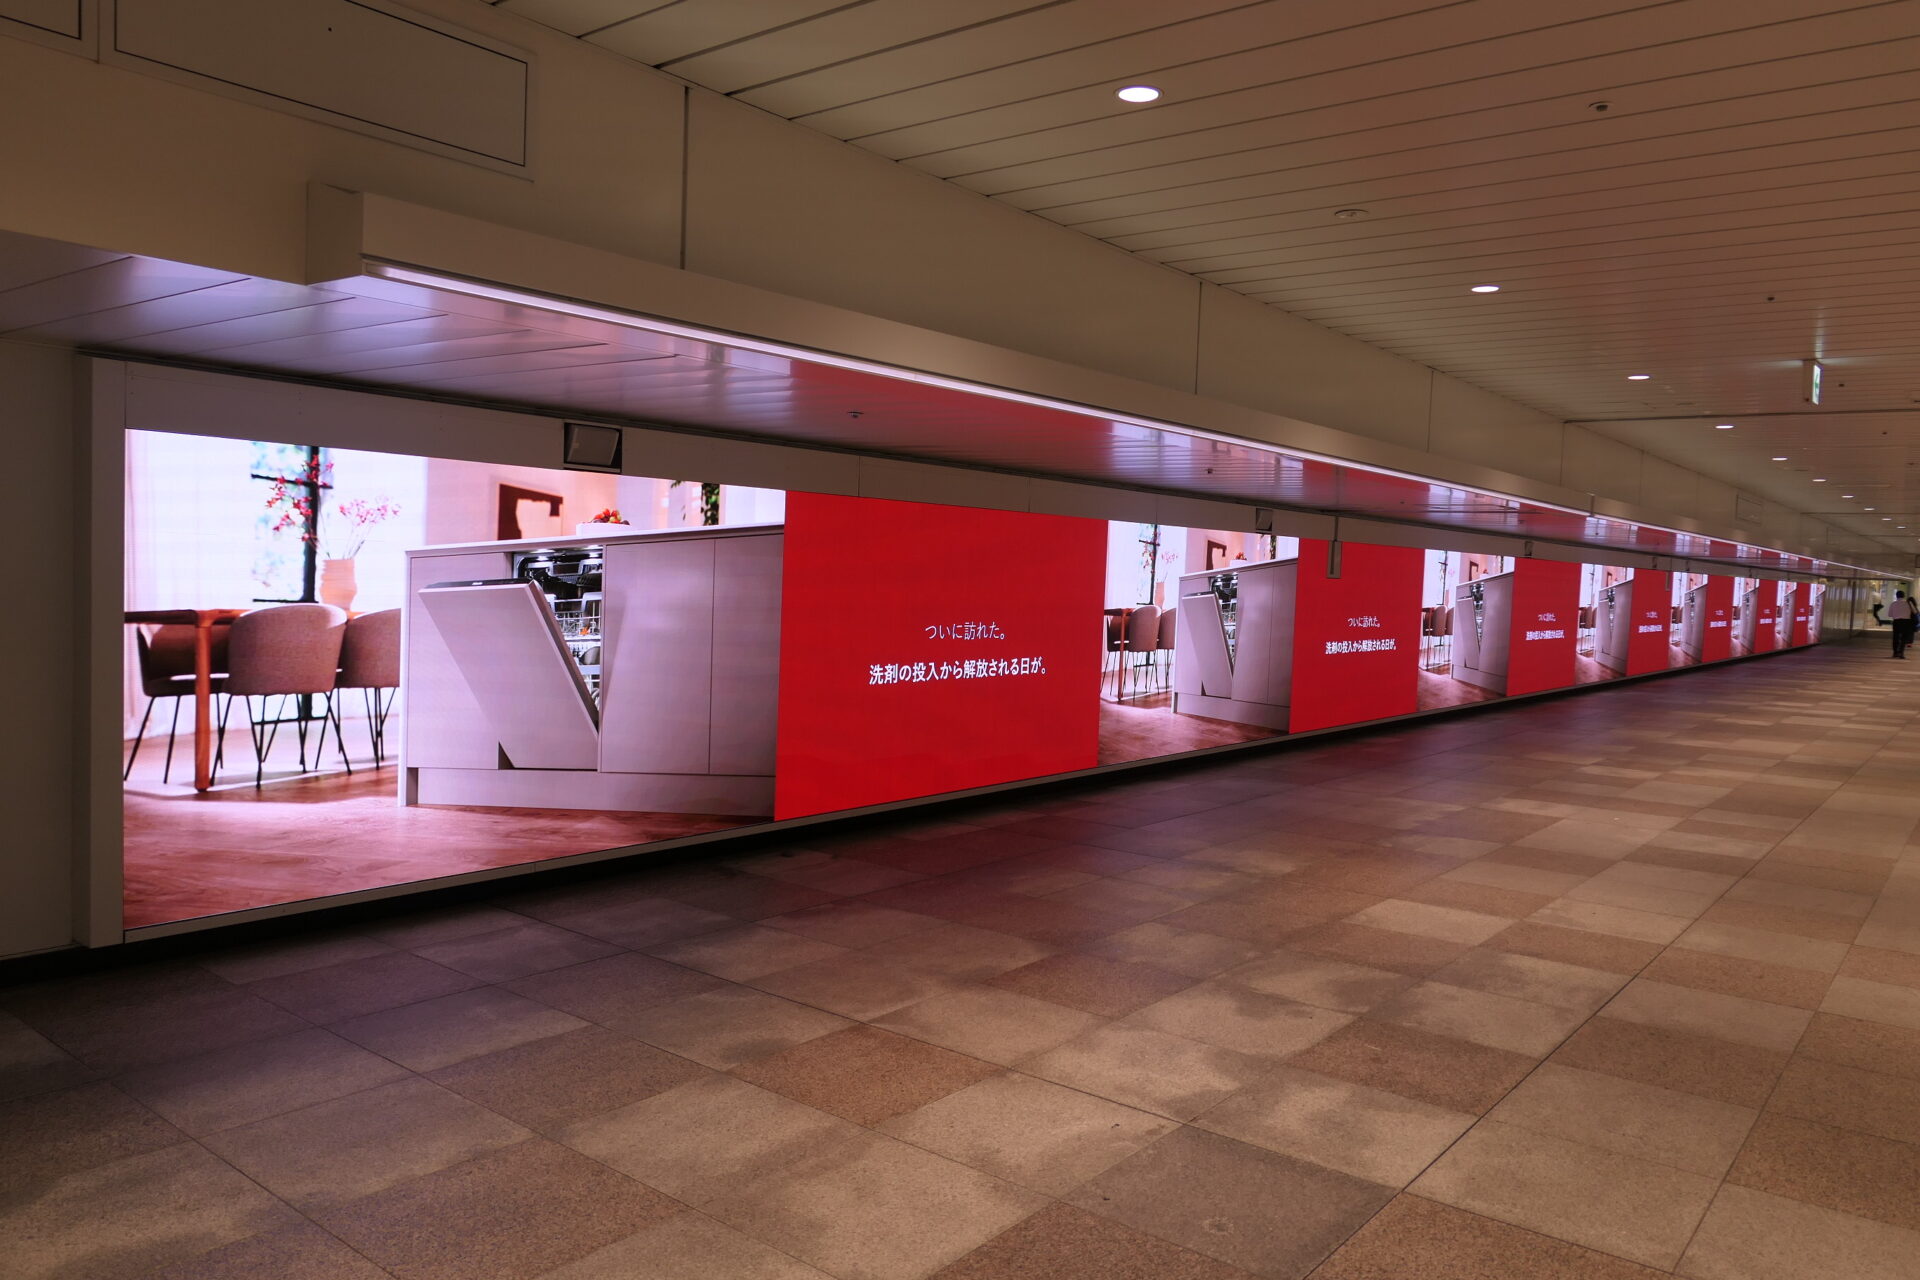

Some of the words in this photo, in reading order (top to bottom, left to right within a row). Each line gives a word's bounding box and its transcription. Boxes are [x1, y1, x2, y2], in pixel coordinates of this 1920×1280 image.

[925, 621, 1006, 641] ついに訪れた。
[869, 656, 1046, 685] 洗剤の投入から解放される日が。
